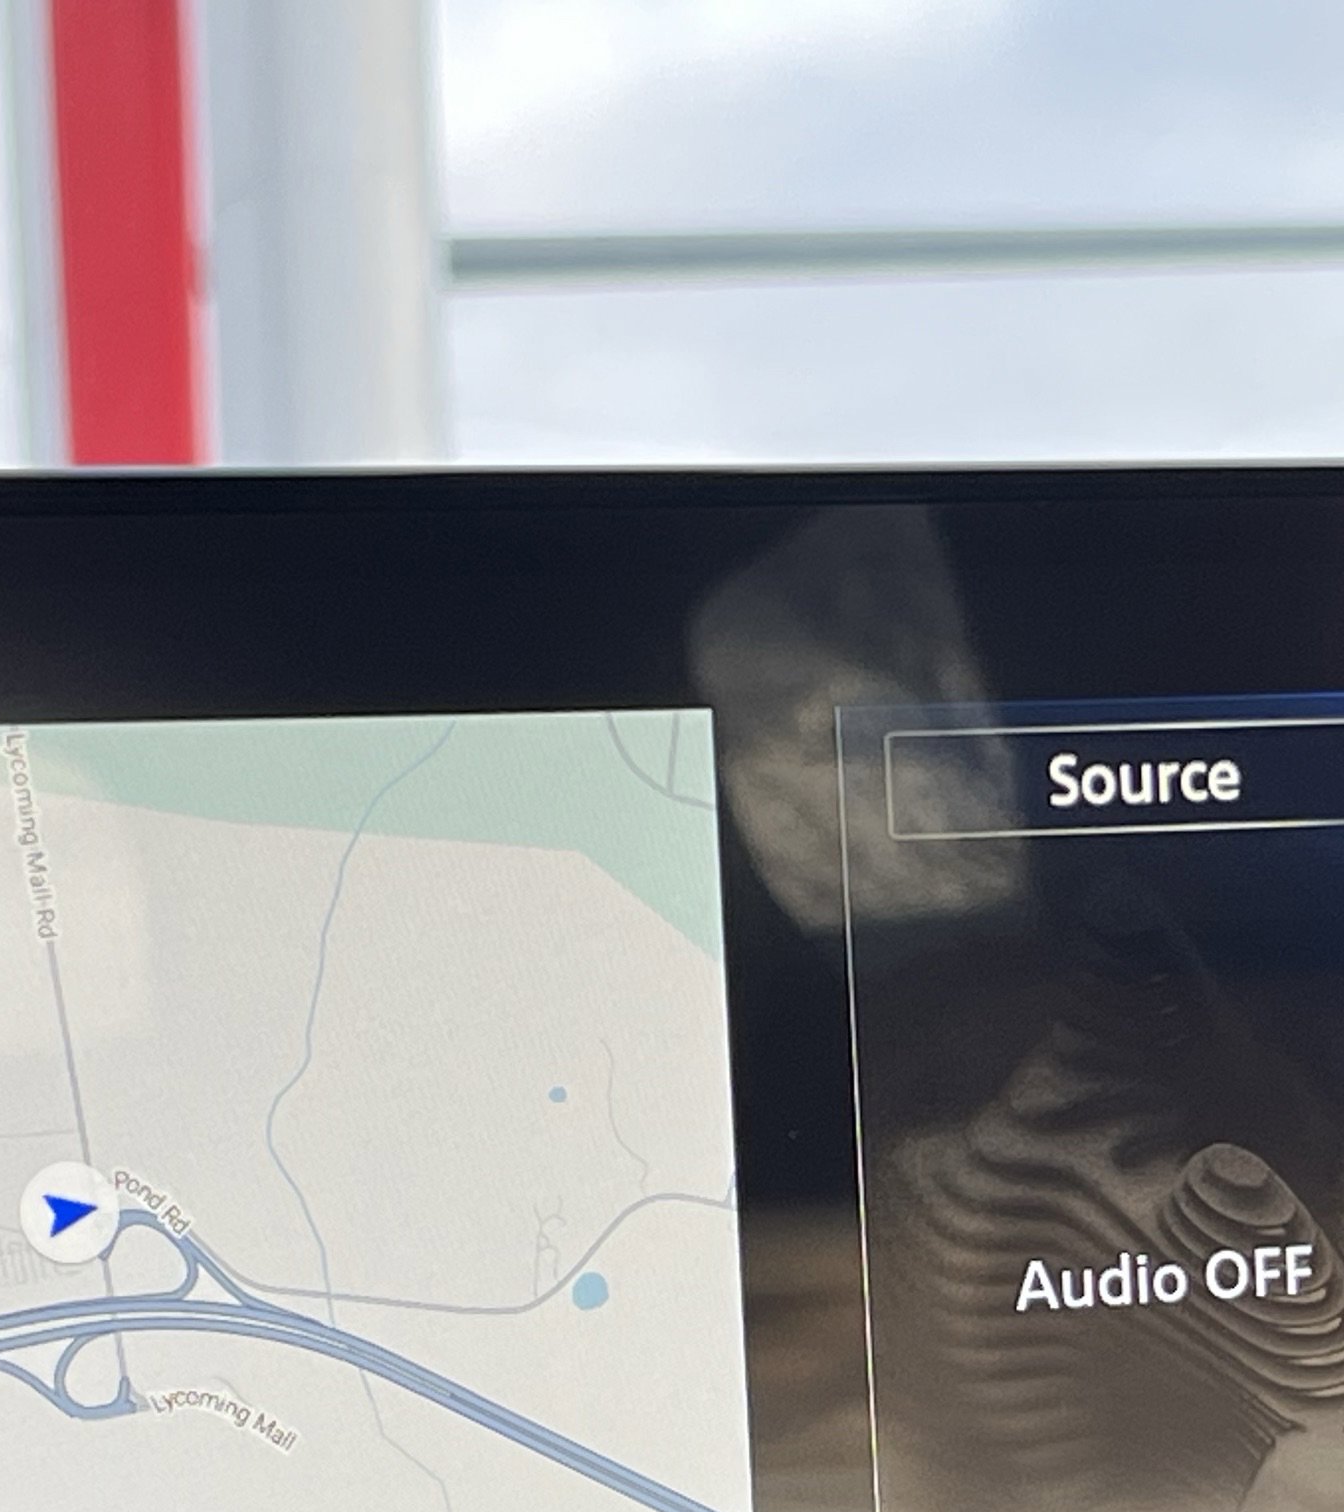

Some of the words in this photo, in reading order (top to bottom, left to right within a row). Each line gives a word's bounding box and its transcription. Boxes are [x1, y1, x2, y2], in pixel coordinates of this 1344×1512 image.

[2, 732, 40, 846] Lycoming
[1048, 753, 1242, 808] Source
[27, 850, 53, 901] Mall
[37, 907, 58, 940] Rd
[160, 1204, 192, 1236] Rd
[1015, 1252, 1189, 1312] Audio
[1204, 1244, 1313, 1298] OFF
[151, 1386, 249, 1427] Lycoming
[252, 1412, 298, 1452] Mall
